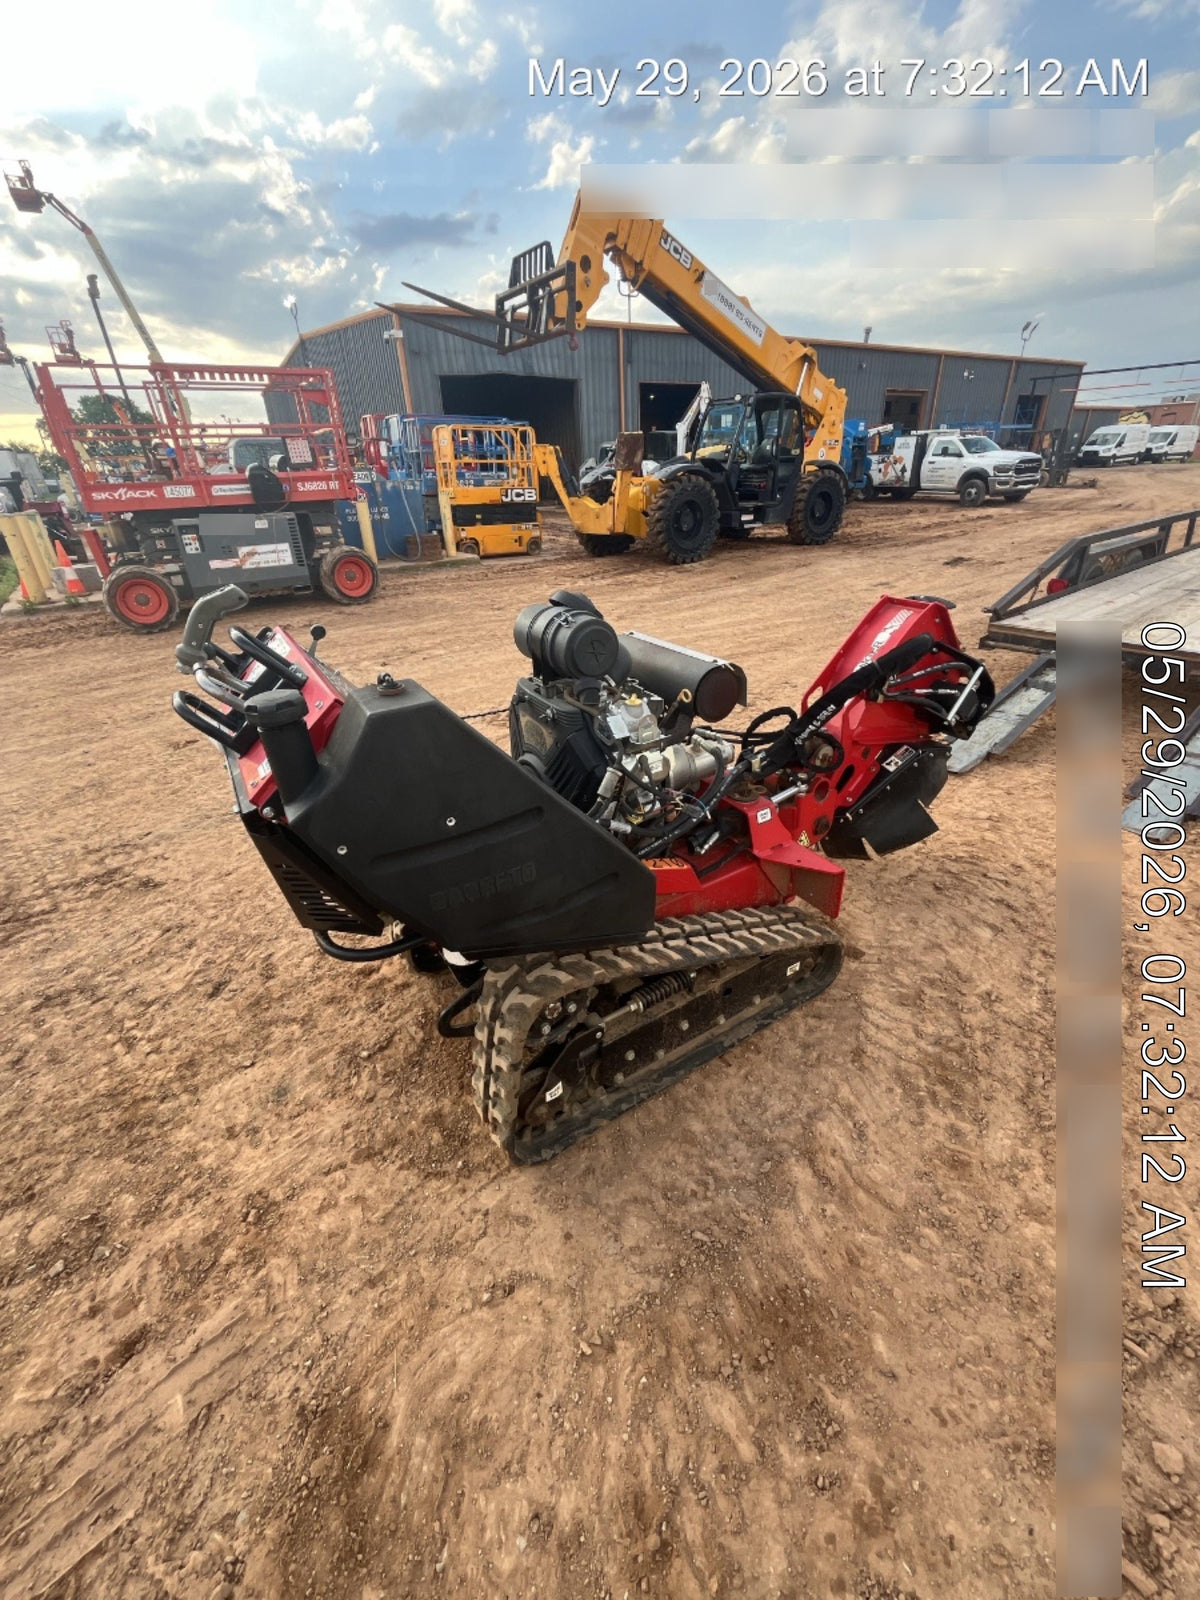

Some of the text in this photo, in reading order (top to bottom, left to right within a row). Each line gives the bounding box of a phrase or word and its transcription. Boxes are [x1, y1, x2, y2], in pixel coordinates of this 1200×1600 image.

[661, 235, 693, 270] JCB
[91, 487, 158, 500] SKYJACK
[501, 488, 537, 502] JCB
